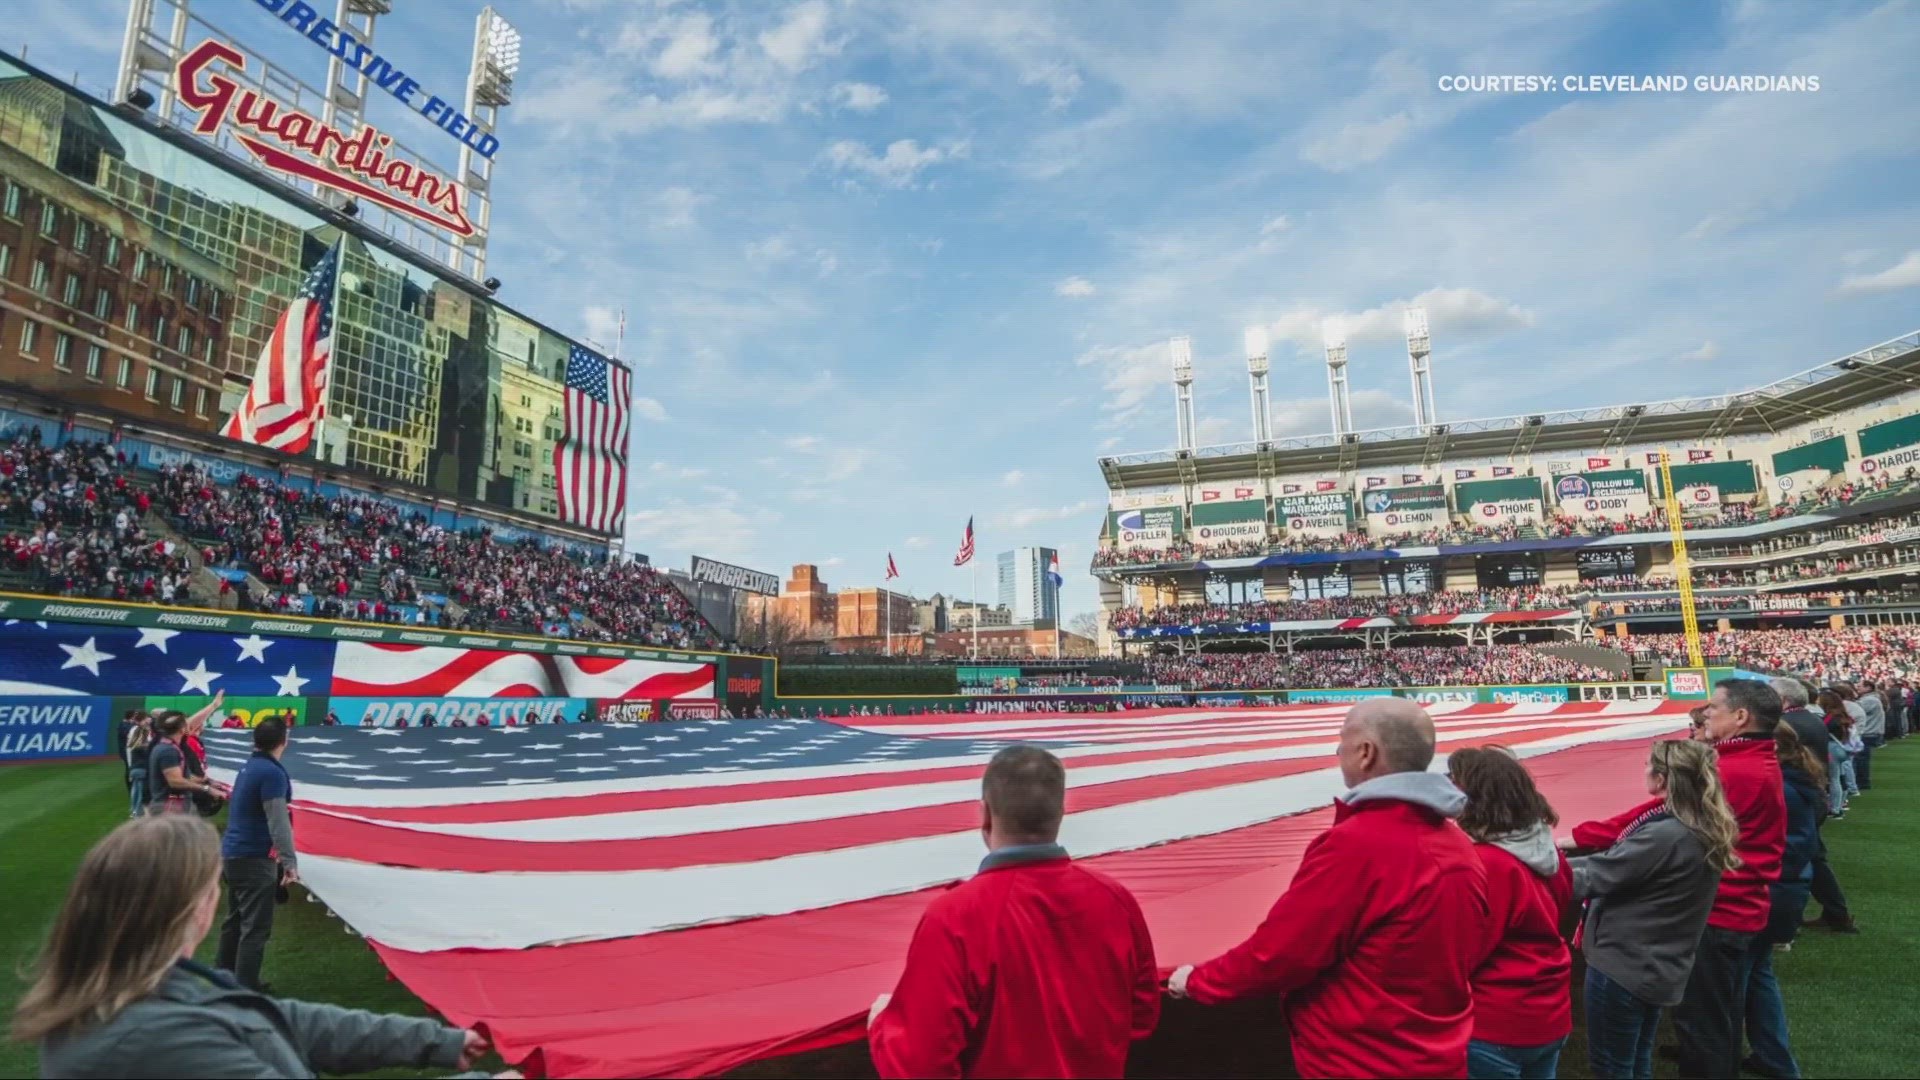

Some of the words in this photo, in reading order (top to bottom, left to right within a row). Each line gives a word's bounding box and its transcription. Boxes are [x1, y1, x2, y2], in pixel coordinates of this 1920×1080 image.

[420, 95, 501, 158] FIELD
[174, 38, 474, 236] Guardians
[1592, 480, 1622, 489] FOLLOW
[1623, 479, 1634, 487] US
[1284, 497, 1305, 506] CAR
[1308, 494, 1343, 504] PARTS
[1601, 498, 1628, 509] DOBY
[1282, 502, 1347, 514] WAREHOUSE
[1500, 503, 1534, 514] THOME
[1305, 518, 1343, 528] AVERILL
[1400, 513, 1433, 523] LEMON
[1136, 530, 1166, 540] FELLER
[1213, 525, 1260, 537] BOUDREAU
[693, 559, 779, 595] PROGRESSIVE
[1749, 600, 1767, 611] THE
[42, 604, 132, 621] PROGRESSIVE
[157, 613, 229, 628] PROGRESSIVE
[1673, 673, 1697, 684] drug
[727, 674, 761, 698] meijer
[961, 687, 992, 696] MOEN
[1028, 687, 1057, 696] MOEN
[1093, 686, 1121, 694] MOEN
[1676, 684, 1703, 692] mart
[1406, 691, 1474, 704] MOEN
[975, 701, 1024, 713] UNION
[358, 701, 567, 727] PROGRESSIVE
